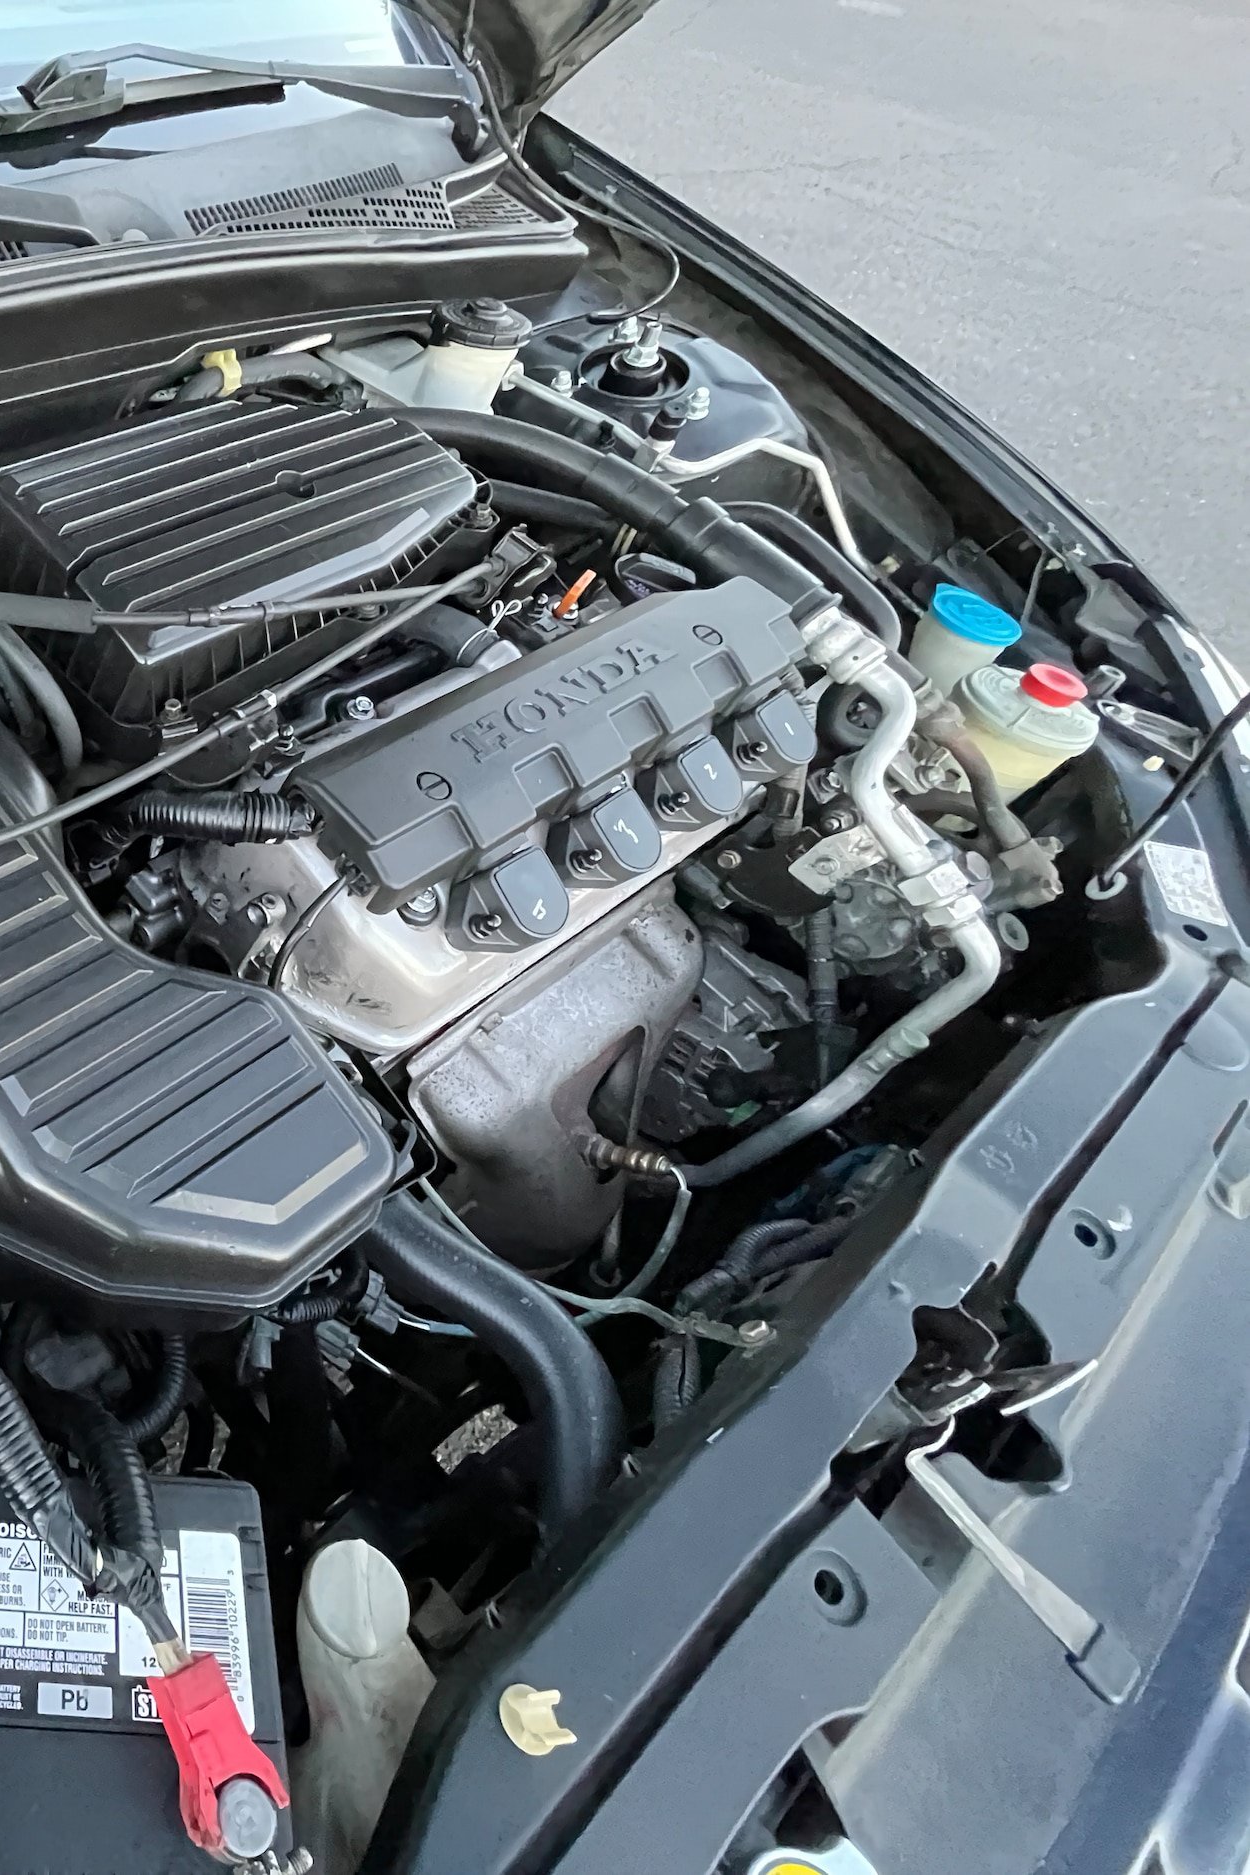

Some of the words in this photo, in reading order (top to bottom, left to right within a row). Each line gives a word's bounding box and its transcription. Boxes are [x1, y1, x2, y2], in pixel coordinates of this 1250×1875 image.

[451, 638, 677, 763] HONDA
[784, 722, 795, 737] 1
[703, 763, 717, 780] 2
[614, 817, 638, 844] 3
[43, 1566, 63, 1578] WITH
[12, 1584, 22, 1594] OR
[0, 1595, 26, 1606] BURNS.
[68, 1601, 88, 1614] HELP
[91, 1603, 113, 1615] FAST.
[227, 1591, 239, 1629] 10229
[27, 1618, 38, 1629] DO
[39, 1619, 54, 1630] NOT
[56, 1620, 74, 1631] OPEN
[76, 1622, 109, 1634] BATTERY.
[27, 1629, 38, 1640] DO
[39, 1630, 54, 1641] NOT
[56, 1632, 69, 1642] TIP.
[5, 1647, 54, 1661] DISASSEMBLE
[54, 1650, 65, 1661] OR
[66, 1651, 108, 1665] INCINERATE.
[14, 1659, 51, 1672] CHARGING
[52, 1662, 105, 1676] INSTRUCTIONS.
[62, 1688, 89, 1711] Pb
